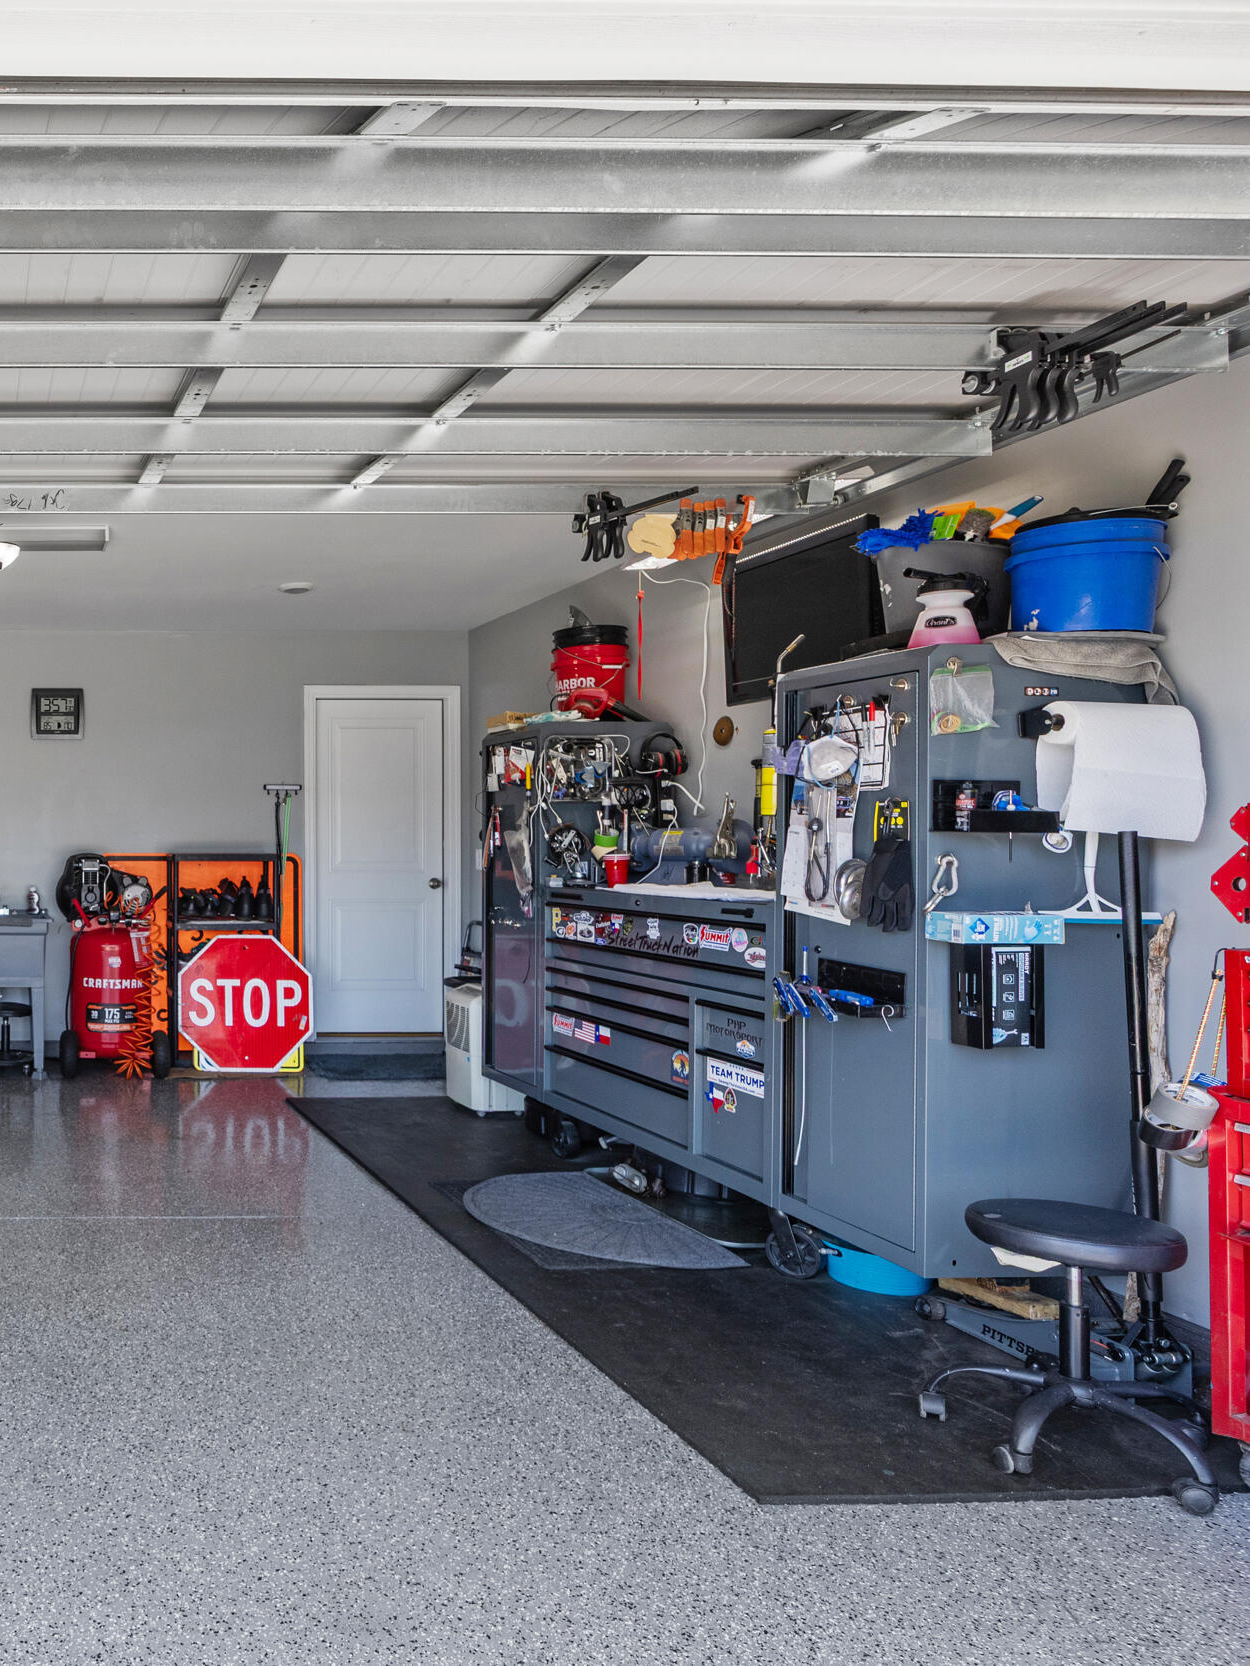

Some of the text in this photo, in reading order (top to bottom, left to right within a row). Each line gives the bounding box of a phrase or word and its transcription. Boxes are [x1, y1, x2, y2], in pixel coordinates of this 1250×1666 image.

[82, 977, 143, 989] CRAFTSMAN
[188, 977, 303, 1028] STOP
[104, 1008, 120, 1019] 175
[710, 1064, 765, 1089] TEAM TRUMP
